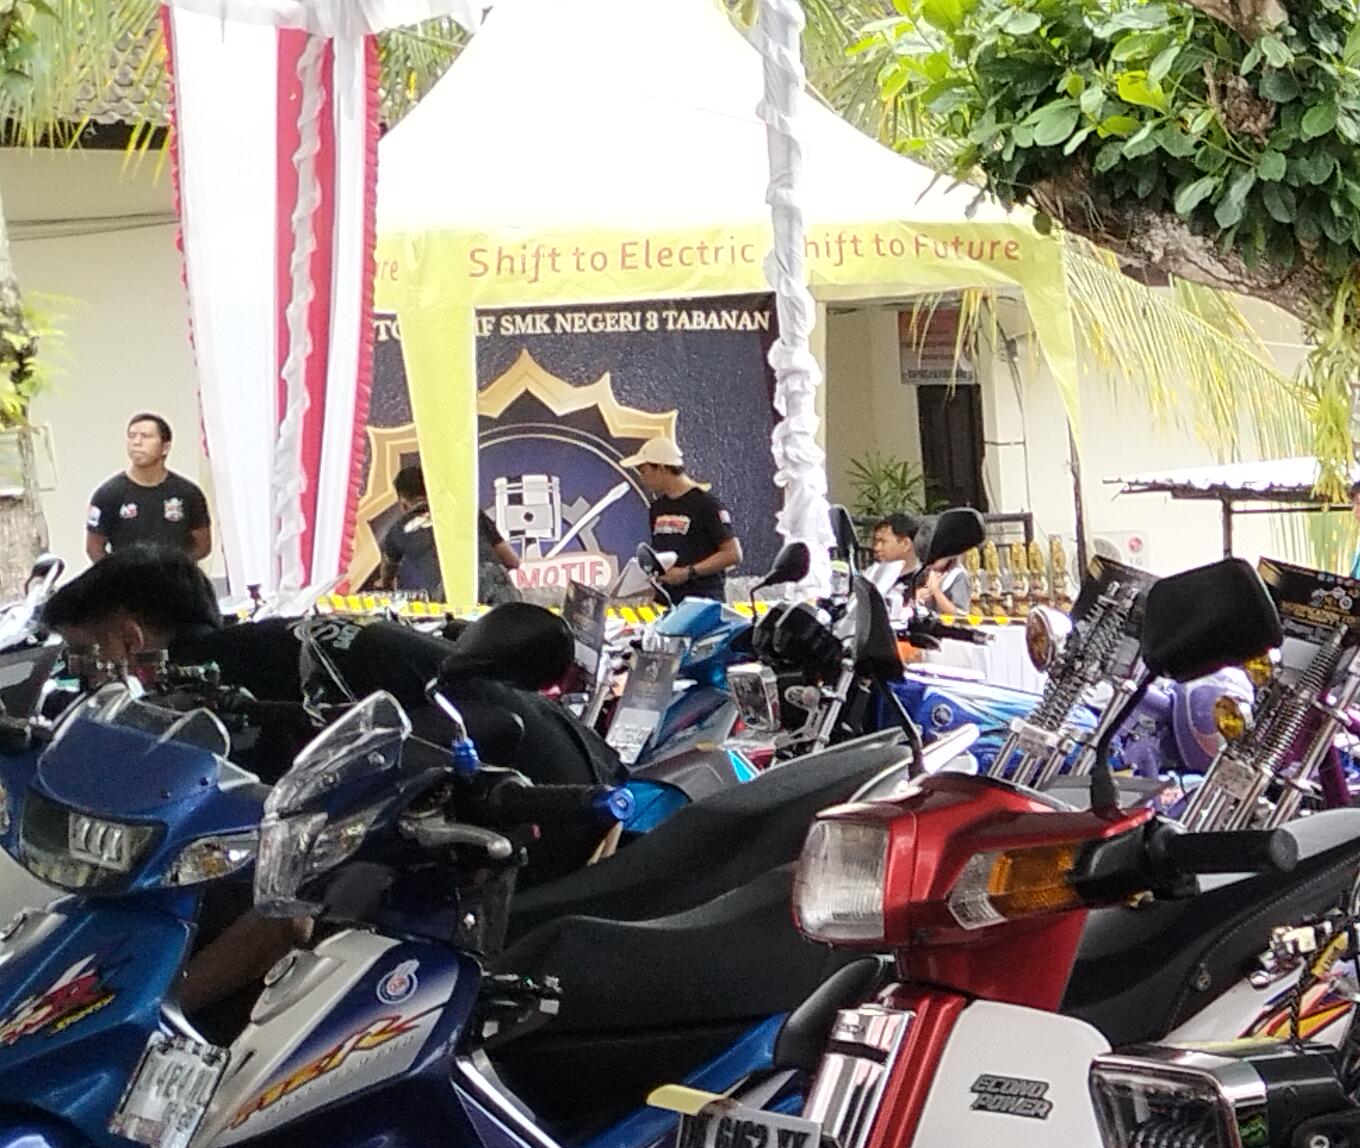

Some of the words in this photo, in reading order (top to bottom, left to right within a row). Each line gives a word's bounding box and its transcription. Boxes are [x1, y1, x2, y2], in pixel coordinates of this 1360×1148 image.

[469, 245, 562, 283] Shift
[575, 249, 608, 274] to
[620, 236, 756, 272] Electric
[803, 232, 864, 265] hift
[875, 235, 905, 259] to
[914, 235, 1021, 261] Future
[499, 313, 549, 336] SMK
[554, 311, 642, 334] NEGERI
[662, 310, 771, 332] TABANAN
[971, 1074, 1049, 1098] ECONO
[969, 1094, 1053, 1120] POWER
